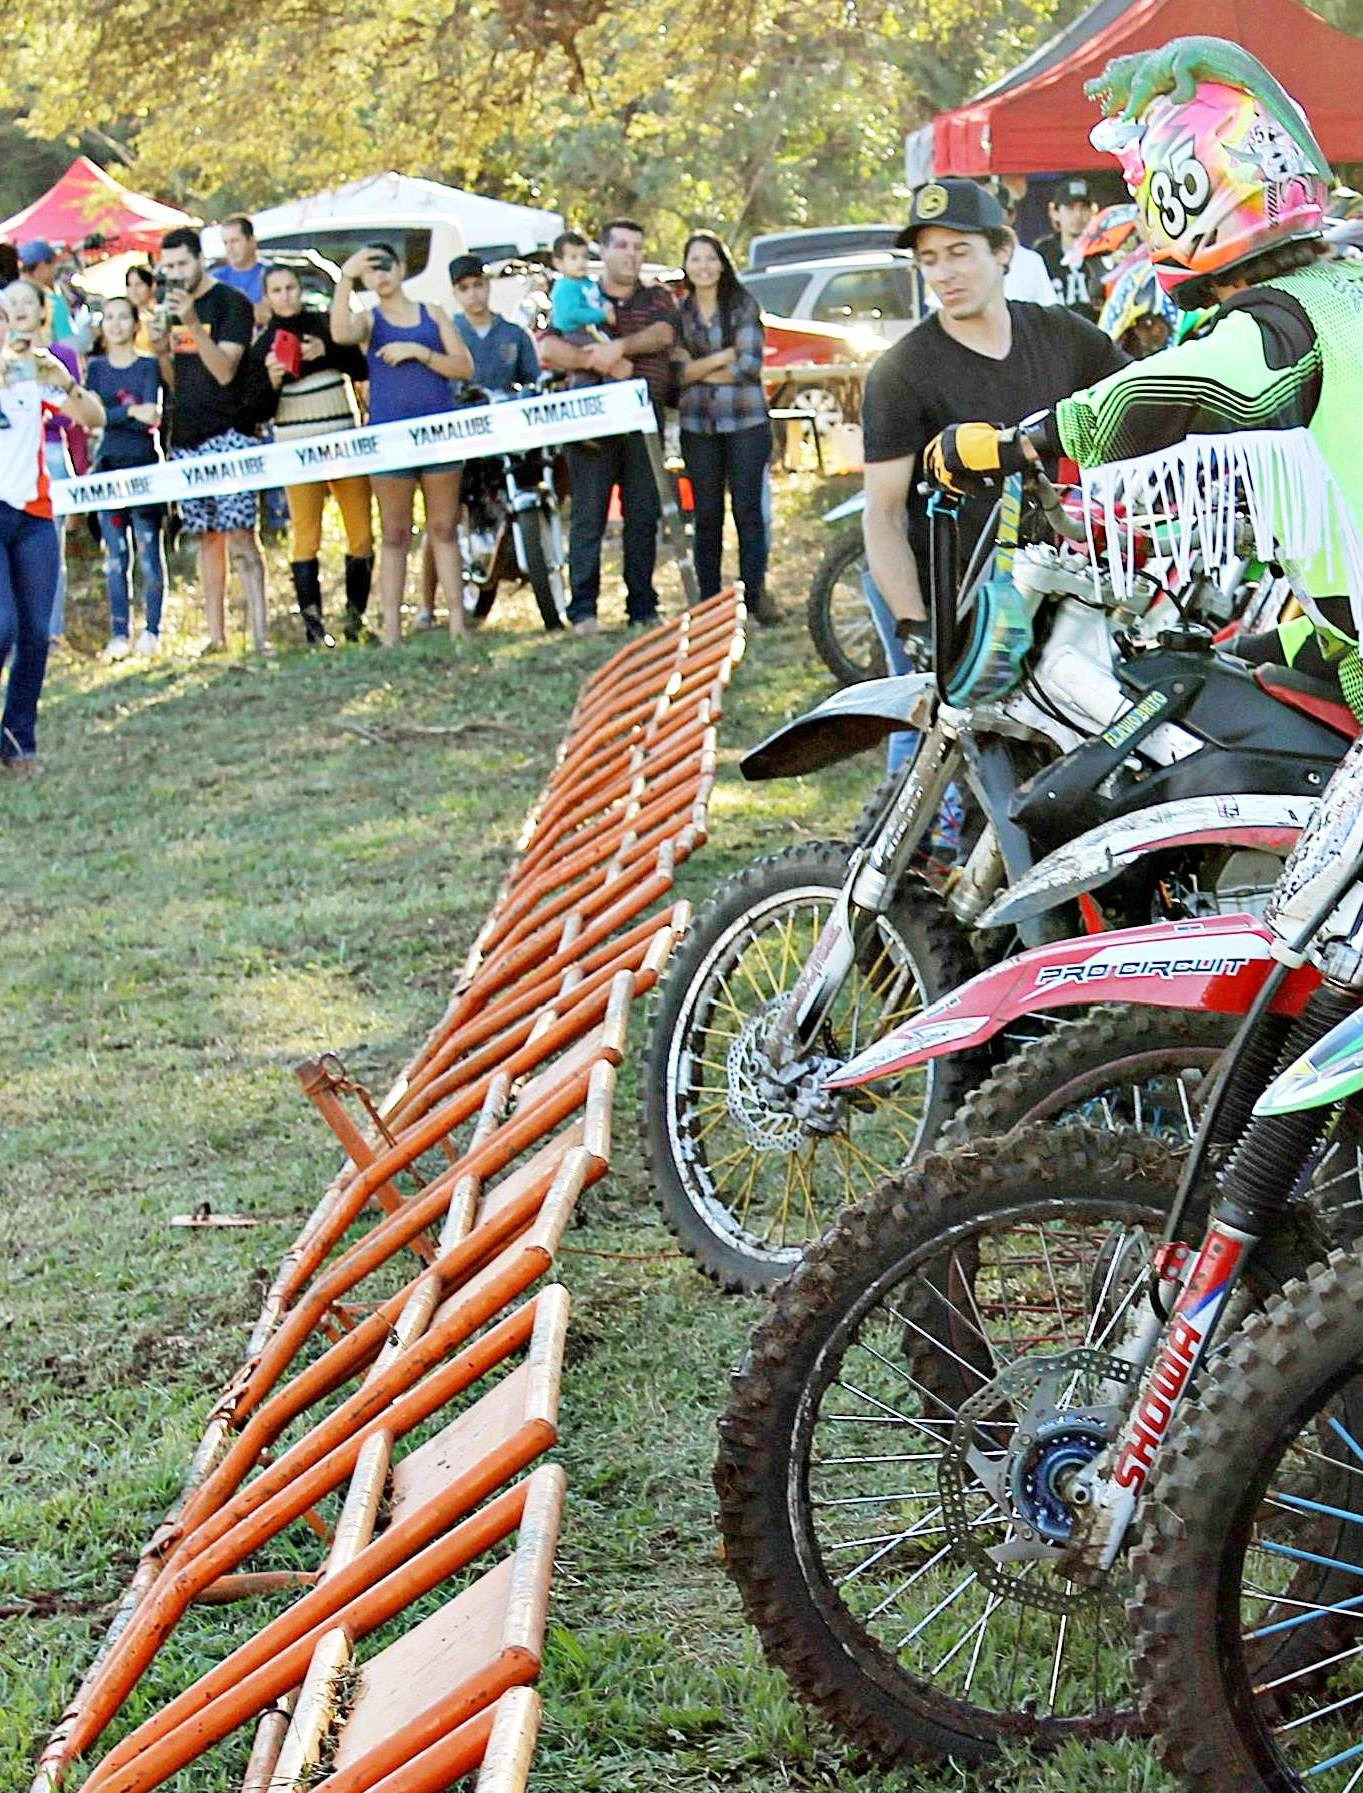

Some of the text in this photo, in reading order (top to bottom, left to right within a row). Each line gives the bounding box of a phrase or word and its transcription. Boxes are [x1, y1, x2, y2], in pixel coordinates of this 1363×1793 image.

[1148, 135, 1210, 240] 85
[68, 475, 150, 504] YAMALUBE
[182, 456, 267, 486] YAMALUBE
[296, 434, 380, 466] YAMALUBE
[408, 414, 494, 447] YAMALUBE
[522, 393, 608, 426] YAMALUBE
[1039, 957, 1247, 983] PRO CIRCUIT
[1115, 1317, 1202, 1497] SHOWA
